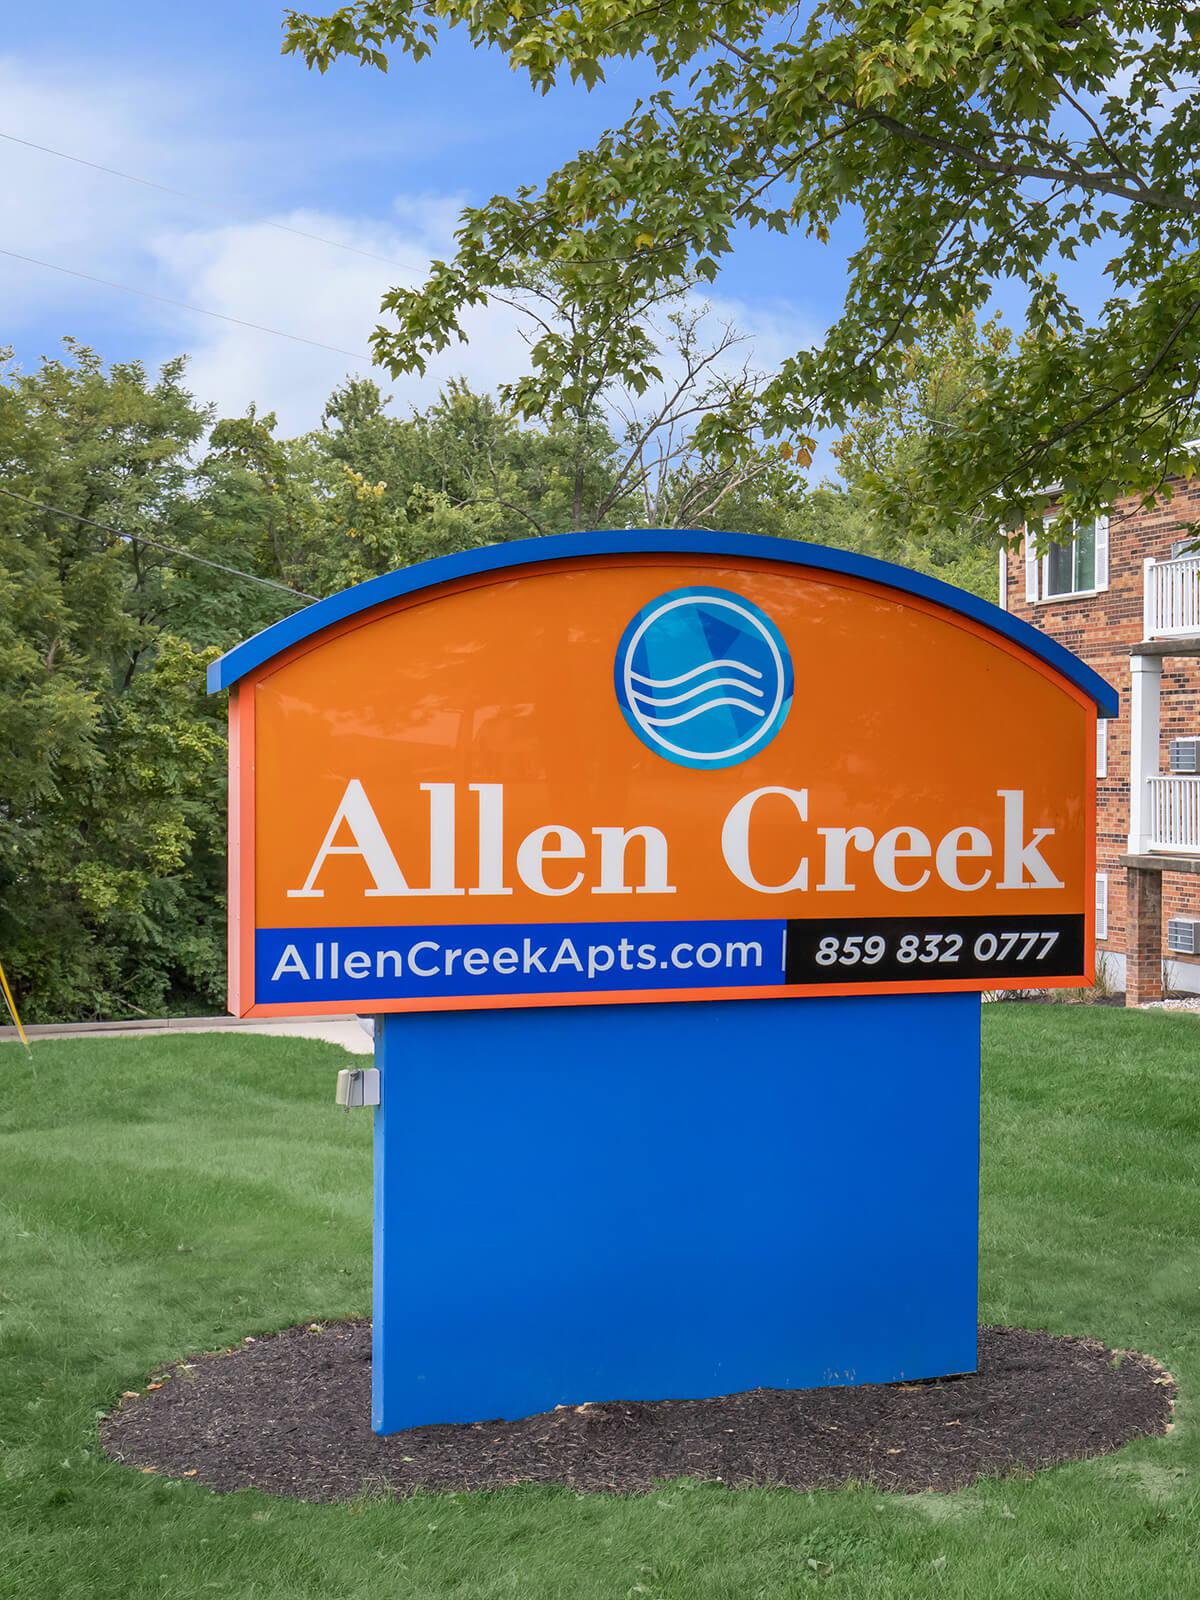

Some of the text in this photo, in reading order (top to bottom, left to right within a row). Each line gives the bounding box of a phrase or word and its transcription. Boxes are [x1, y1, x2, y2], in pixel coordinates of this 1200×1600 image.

[287, 779, 1064, 897] Allen Creek
[272, 938, 762, 980] AllenCreekApts.com
[816, 932, 1059, 965] 859 832 0777
